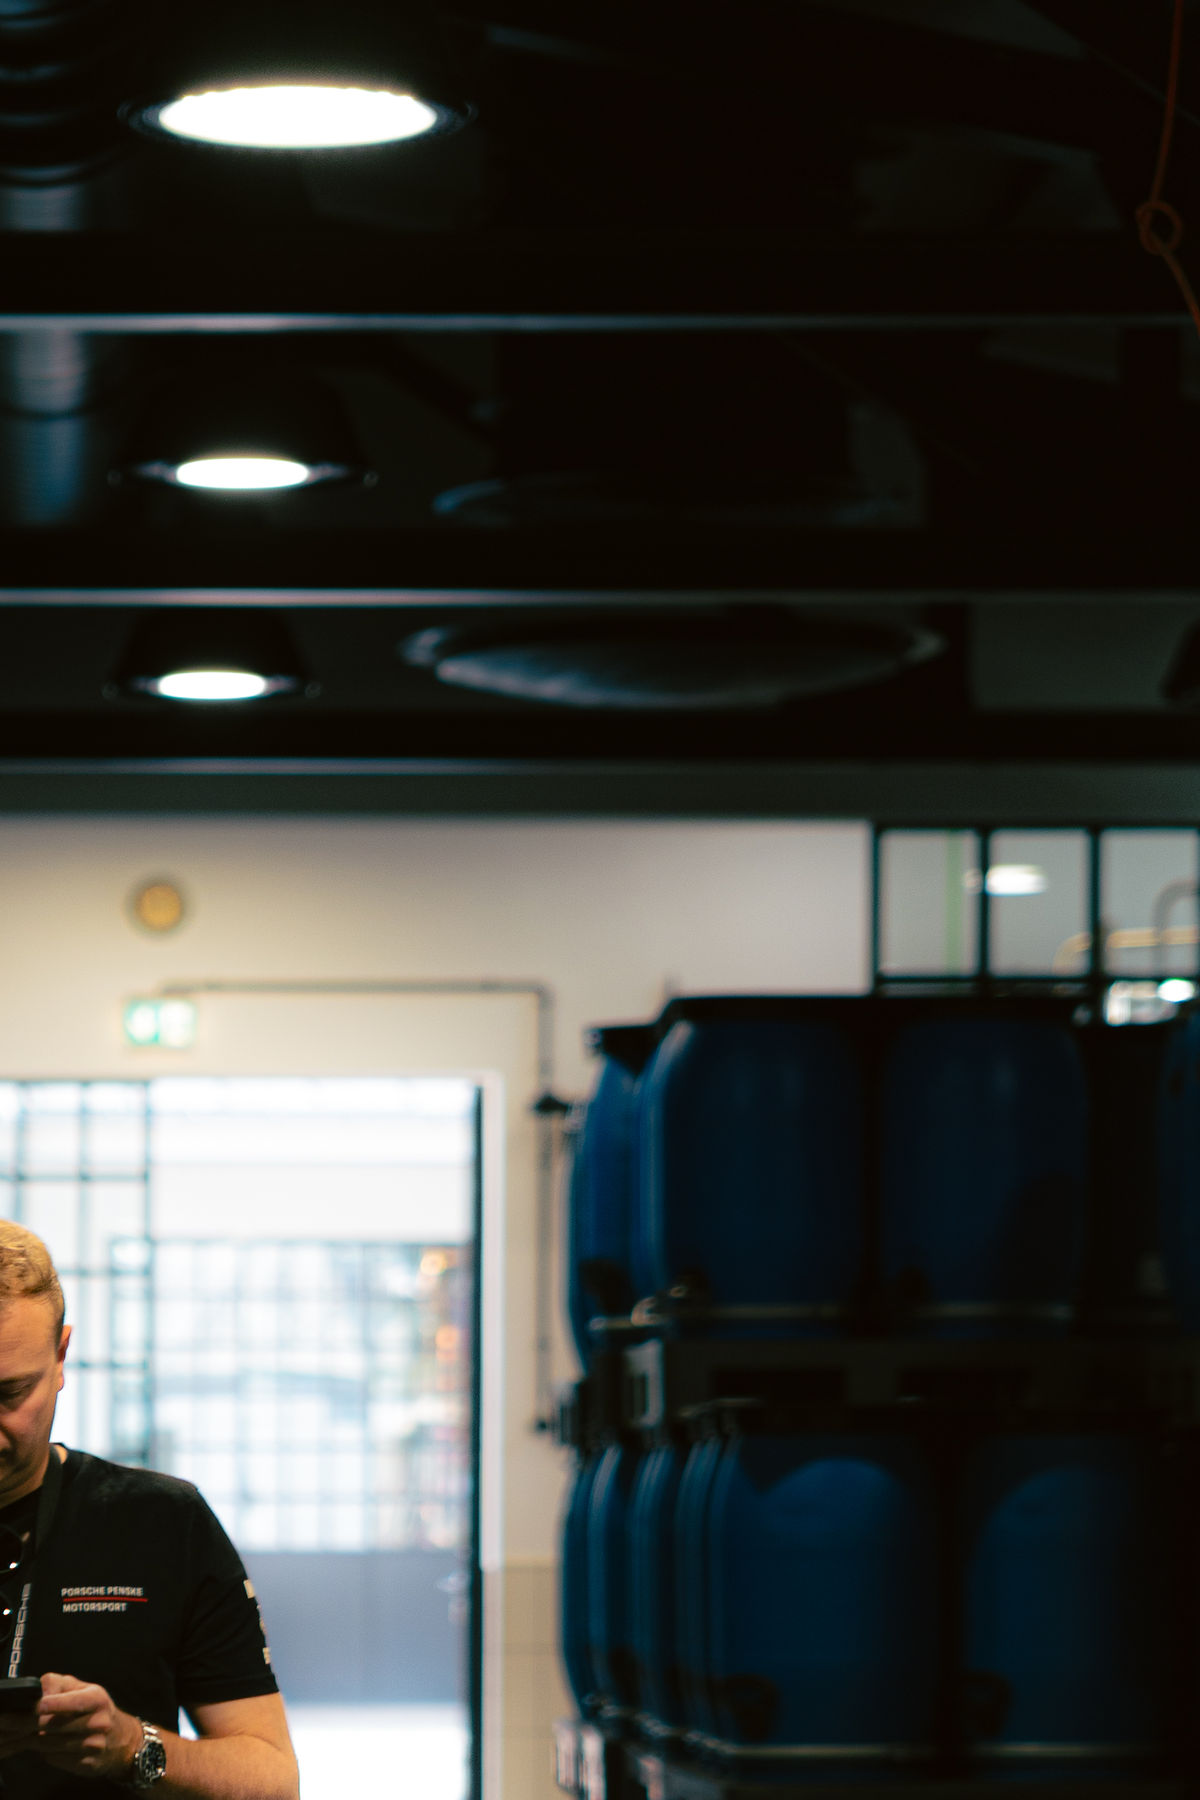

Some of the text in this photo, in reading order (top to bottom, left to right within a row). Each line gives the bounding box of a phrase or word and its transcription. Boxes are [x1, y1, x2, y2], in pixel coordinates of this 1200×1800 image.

[61, 1586, 143, 1597] PORSCHE PENSKE
[62, 1602, 127, 1613] MOTORSPORT
[8, 1583, 32, 1678] PORSCHE
